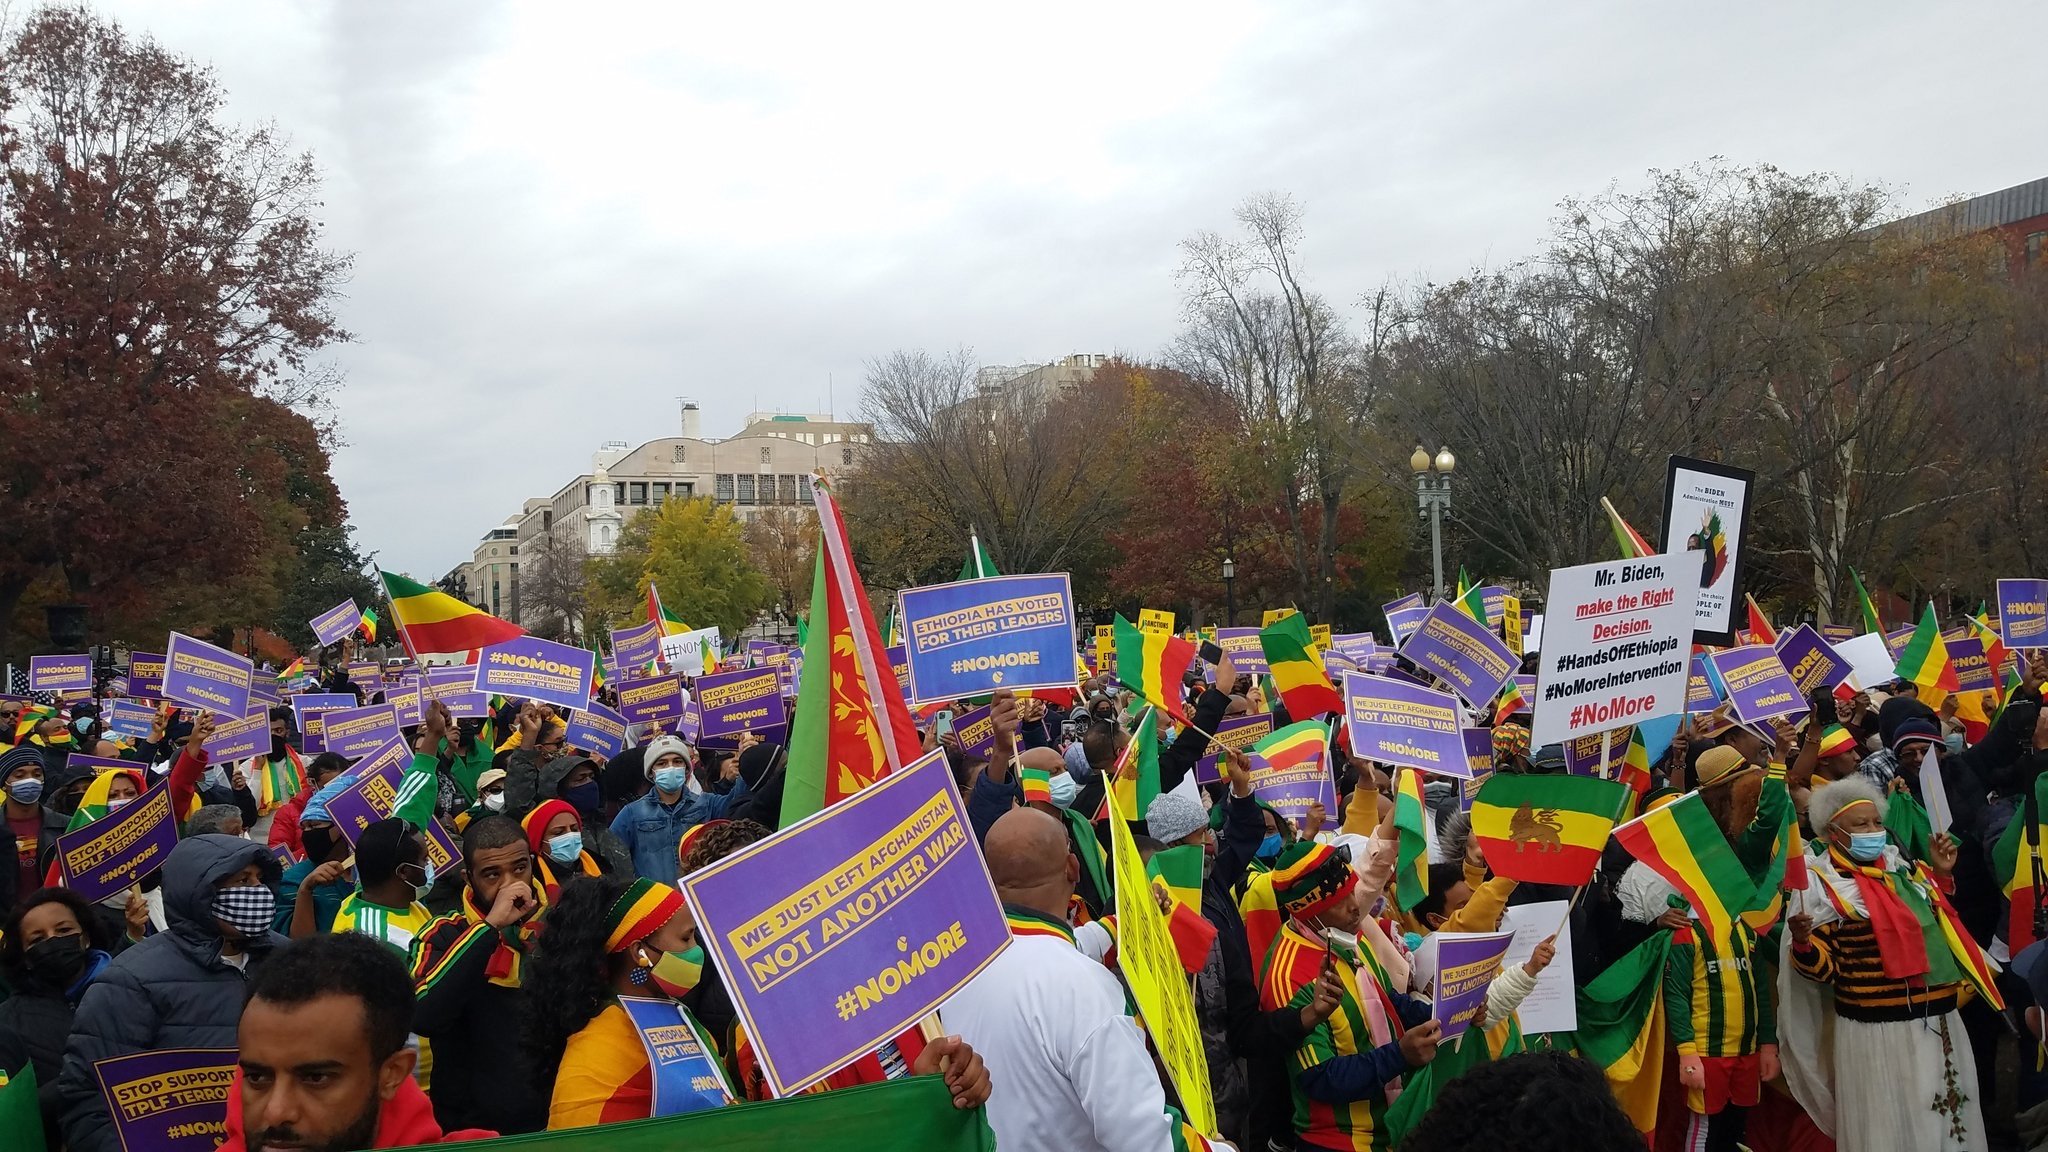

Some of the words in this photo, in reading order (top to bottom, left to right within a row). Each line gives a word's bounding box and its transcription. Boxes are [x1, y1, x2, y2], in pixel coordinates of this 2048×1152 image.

[1682, 493, 1718, 504] Administration
[1719, 500, 1734, 508] MUST
[1704, 488, 1725, 497] BIDEN
[1594, 570, 1616, 587] Mr.
[1621, 564, 1664, 584] Biden,
[1576, 599, 1613, 618] make
[1617, 594, 1640, 610] the
[1642, 587, 1674, 608] Right
[917, 611, 983, 634] ETHIOPIA
[986, 603, 1014, 618] HAS
[1016, 597, 1058, 611] VOTED
[918, 633, 950, 650] FOR
[956, 622, 997, 640] THEIR
[1000, 610, 1063, 630] LEADERS
[1099, 628, 1108, 637] US
[1593, 618, 1652, 640] Decision.
[664, 634, 719, 660] #NOMRE
[1221, 638, 1239, 646] STOP
[950, 651, 1040, 674] #NOMORE
[1424, 626, 1443, 640] NOT
[1444, 636, 1483, 665] ANOTHER
[1484, 661, 1504, 681] WAR
[1557, 636, 1678, 673] #HandsOffEthiopia
[36, 665, 87, 674] #NOMORE
[490, 652, 582, 679] #NOMORE
[1426, 652, 1472, 687] #NOMORE
[1736, 668, 1748, 678] JUST
[174, 663, 192, 674] NOT
[193, 666, 230, 682] ANOTHER
[231, 676, 248, 687] WAR
[528, 674, 579, 686] UNDERMINING
[1545, 661, 1682, 701] #NoMoreIntervention
[1731, 680, 1747, 690] NOT
[1748, 671, 1776, 684] ANOTHER
[1801, 658, 1828, 692] DERMINING
[186, 686, 231, 706] #NOMORE
[438, 688, 469, 698] ANOTHER
[546, 682, 578, 692] ETHIOPIA
[622, 690, 640, 698] STOP
[640, 680, 677, 694] SUPPORTING
[703, 688, 727, 700] STOP
[728, 676, 775, 694] SUPPORTING
[624, 697, 640, 705] TPLF
[642, 688, 678, 701] TERRORISTS
[704, 697, 727, 710] TPLF
[730, 684, 777, 703] TERRORISTS
[636, 704, 670, 715] #NOMORE
[722, 708, 768, 723] #NOMORE
[1369, 701, 1387, 709] JUST
[1408, 705, 1452, 718] AFGHANISTAN
[1570, 694, 1656, 730] #NoMore
[345, 723, 376, 736] ANOTHER
[378, 718, 394, 728] WAR
[1356, 711, 1379, 720] NOT
[1382, 714, 1430, 728] ANOTHER
[1432, 720, 1456, 732] WAR
[218, 726, 249, 738] ANOTHER
[720, 734, 766, 742] #NORE
[962, 724, 982, 738] STOP
[964, 732, 988, 748] TPLF
[1220, 724, 1268, 741] SUPPORTING
[216, 742, 254, 756] #NOMORE
[345, 740, 383, 751] #NOMORE
[582, 733, 612, 750] #NOMORE
[1578, 734, 1598, 748] STOP
[379, 746, 400, 763] VOTED
[1203, 745, 1220, 756] PLF
[1378, 740, 1440, 762] #NOMORE
[1578, 745, 1598, 758] TPLF
[1468, 755, 1492, 770] NOMORE
[1263, 773, 1308, 786] ANOTHER
[362, 787, 388, 812] TPLF
[373, 779, 397, 804] STOP
[1267, 798, 1315, 808] NOMORE
[70, 840, 103, 864] STOP
[105, 794, 166, 843] SUPPORTING
[72, 854, 105, 874] TPLF
[108, 804, 169, 856] TERRORISTS
[99, 843, 159, 884] #NOMORE
[740, 921, 774, 949] WE
[776, 890, 822, 928] JUST
[826, 862, 866, 898] LEFT
[868, 799, 950, 870] AFGHANISTAN
[752, 931, 814, 984] NOT
[820, 855, 928, 944] ANOTHER
[924, 821, 964, 864] WAR
[835, 921, 968, 1022] #NOMORE
[1444, 972, 1453, 980] WE
[1455, 969, 1468, 978] JUST
[1469, 966, 1481, 974] LEFT
[1443, 983, 1461, 997] NOT
[1462, 971, 1491, 992] ANOTHER
[649, 1029, 685, 1042] ETHIOPIA
[657, 1046, 678, 1060] FOR
[675, 1043, 701, 1056] THEIR
[117, 1080, 162, 1100] STOP
[167, 1070, 235, 1088] SUPPORT
[124, 1096, 168, 1117] TPLF
